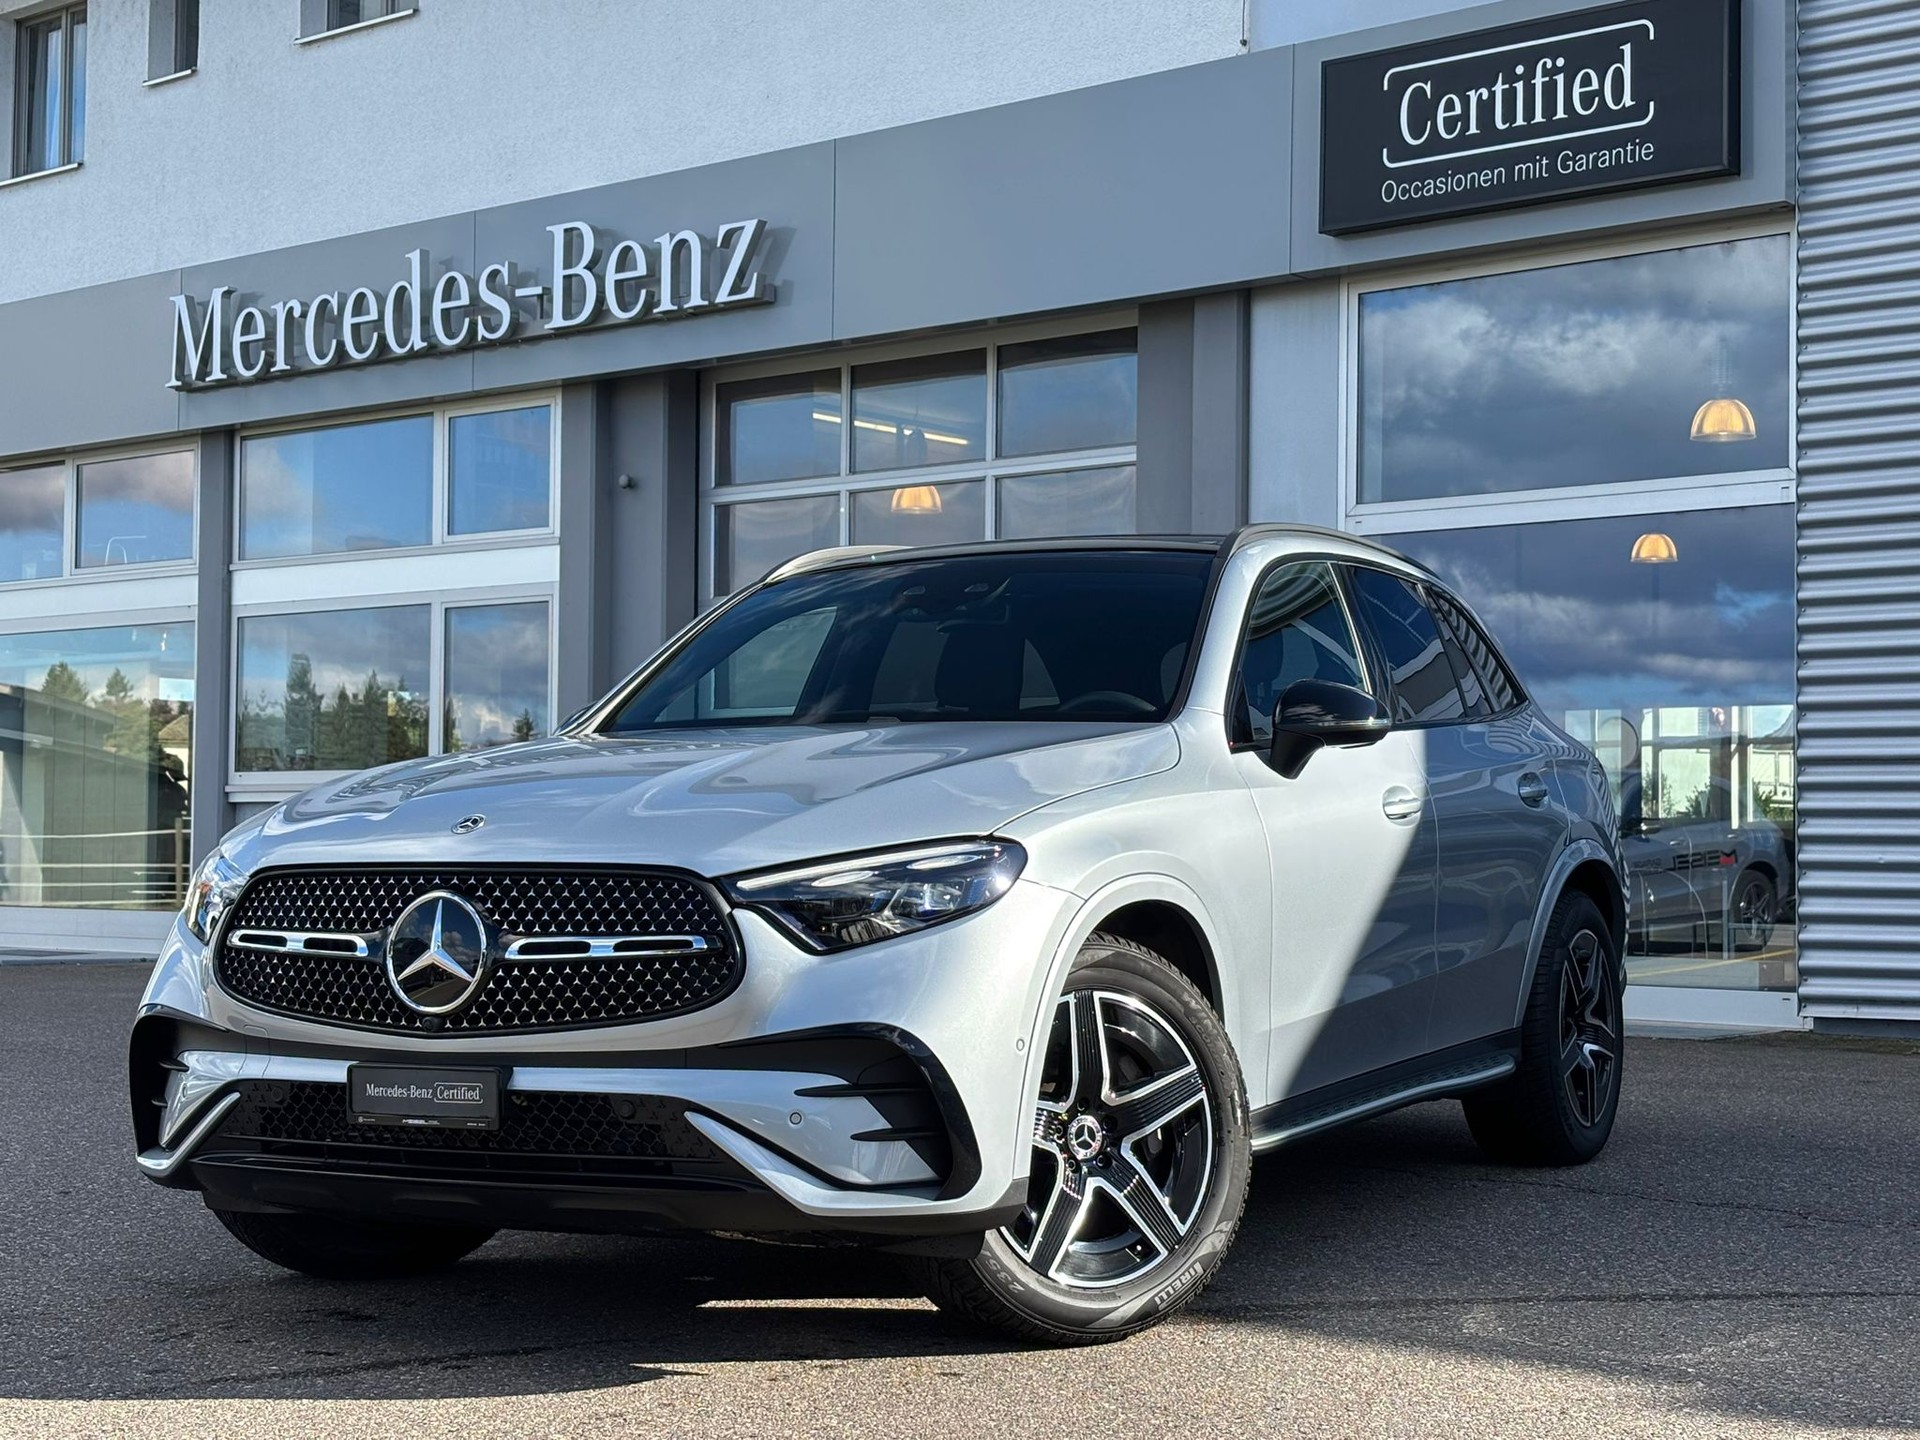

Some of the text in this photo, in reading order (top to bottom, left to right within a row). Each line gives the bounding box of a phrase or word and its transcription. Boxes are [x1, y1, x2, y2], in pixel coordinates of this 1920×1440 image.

[1400, 42, 1636, 146] Certified
[1381, 139, 1655, 203] Occasionen mit Garantie
[165, 218, 769, 389] Mercedes-Benz
[366, 1083, 480, 1100] Mercedes-Benz Certified
[1154, 1261, 1204, 1311] PIRELLI
